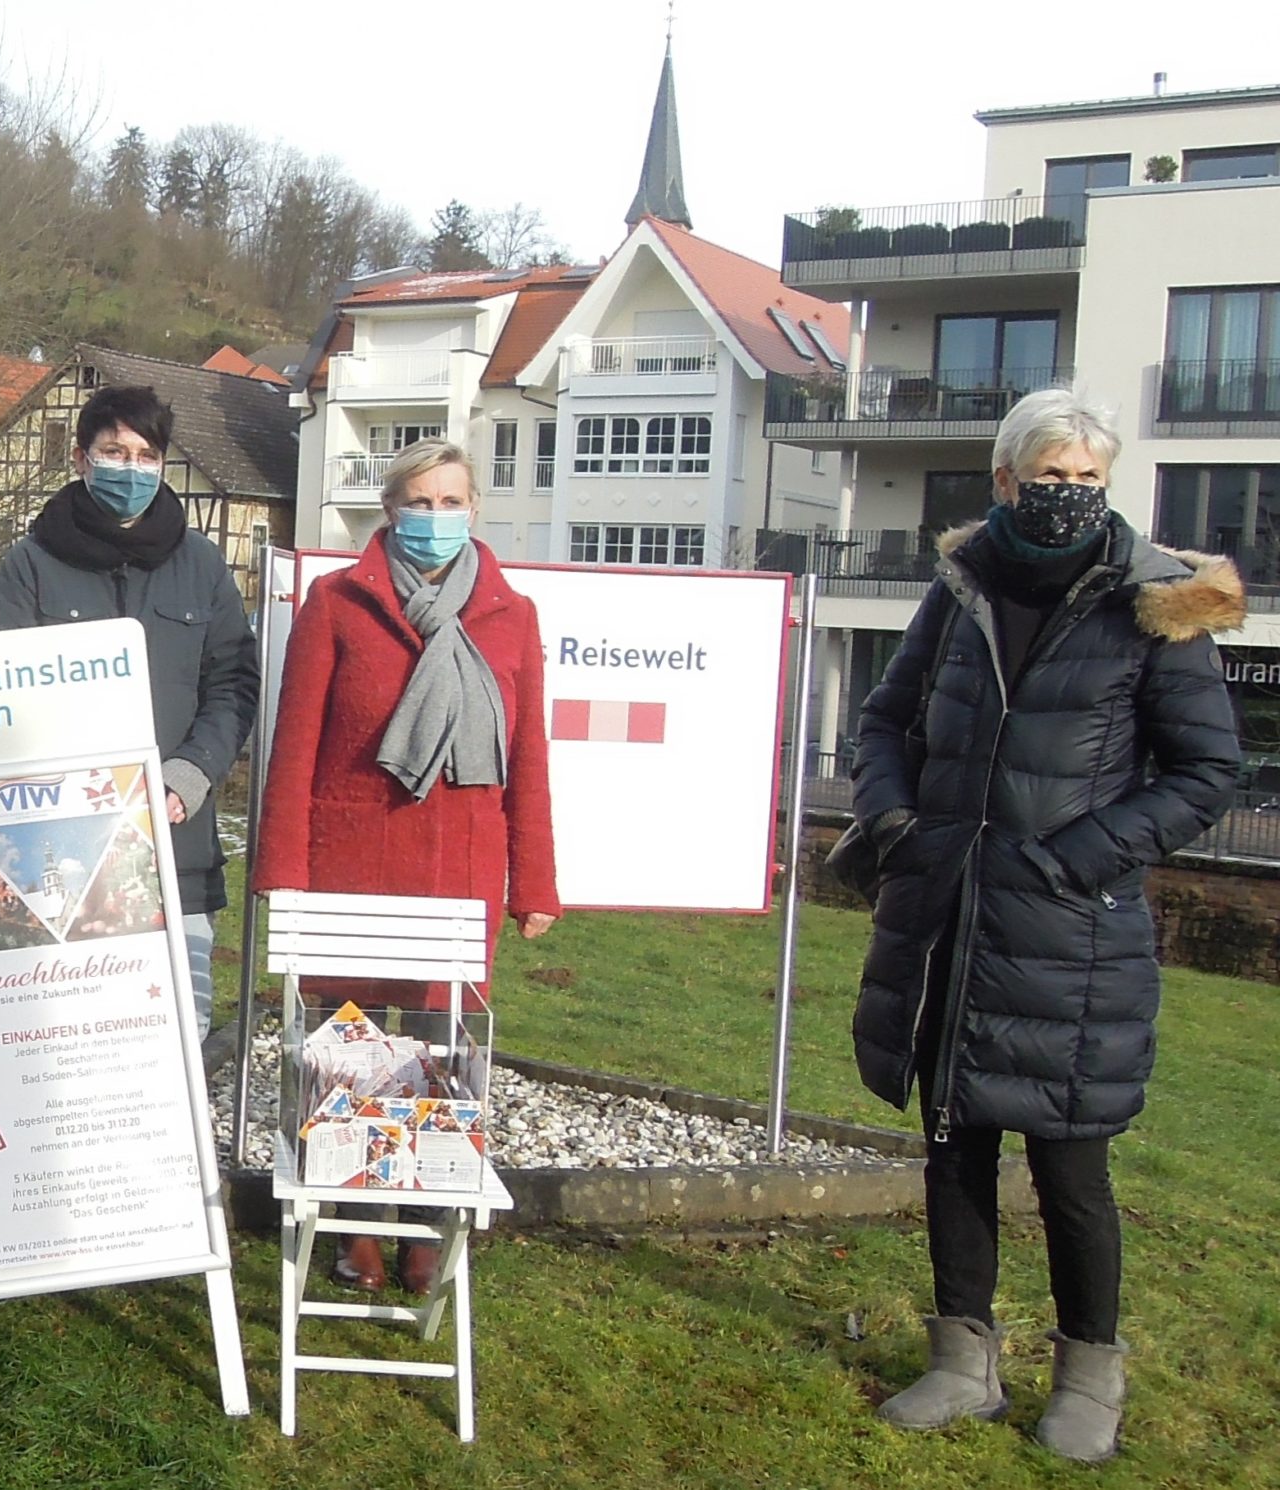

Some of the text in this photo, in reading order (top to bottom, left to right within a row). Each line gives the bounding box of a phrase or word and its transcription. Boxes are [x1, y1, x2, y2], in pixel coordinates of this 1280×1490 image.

[559, 636, 707, 671] Reisewelt
[1225, 662, 1280, 684] uran
[0, 783, 61, 811] VTW
[0, 994, 14, 1004] sie
[18, 991, 38, 1002] eine
[42, 986, 80, 999] Zukunft
[2, 1012, 166, 1045] EINKAUFEN & GEWINNEN
[14, 1046, 40, 1058] Jeder
[43, 1041, 78, 1054] Einkauf
[80, 1039, 88, 1049] in
[91, 1037, 108, 1047] den
[22, 1073, 40, 1084] Bad
[45, 1098, 63, 1109] Alle
[126, 1088, 142, 1099] und
[14, 1110, 88, 1129] abgestempelten
[91, 1120, 104, 1131] bis
[108, 1116, 140, 1129] 3112.20
[30, 1140, 68, 1154] nehmen
[71, 1139, 82, 1148] an
[85, 1137, 99, 1146] der
[14, 1173, 20, 1184] 5
[66, 1164, 94, 1176] winkt
[98, 1162, 112, 1172] die
[12, 1185, 38, 1198] ihres
[42, 1179, 86, 1194] Einkaufs
[12, 1196, 71, 1213] Auszahlung
[74, 1191, 108, 1205] erfolgt
[112, 1190, 120, 1199] in
[2, 1244, 15, 1253] KW
[53, 1236, 76, 1246] online
[80, 1233, 97, 1242] statt
[100, 1231, 114, 1240] und
[116, 1230, 125, 1238] ist
